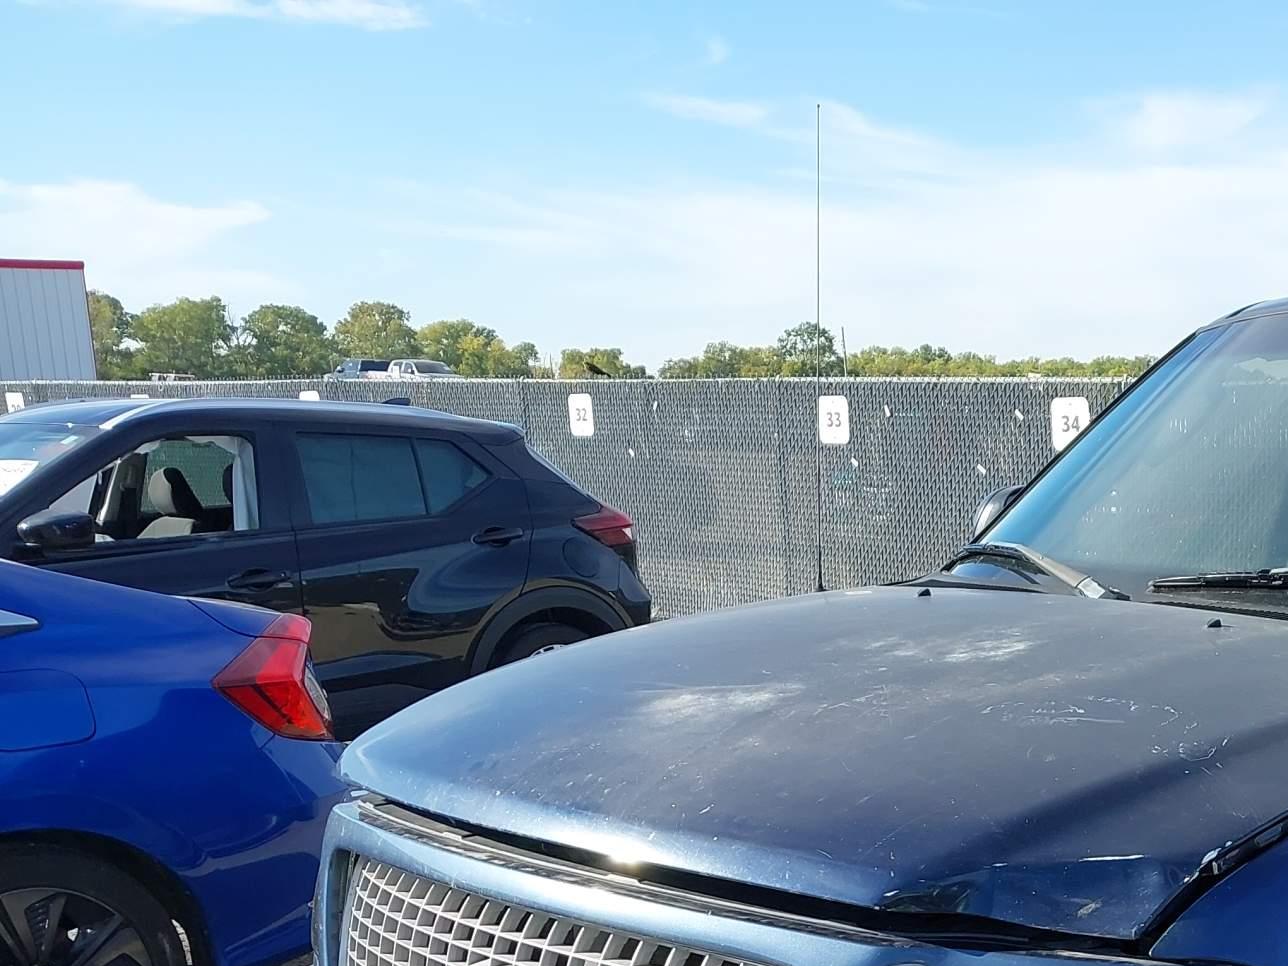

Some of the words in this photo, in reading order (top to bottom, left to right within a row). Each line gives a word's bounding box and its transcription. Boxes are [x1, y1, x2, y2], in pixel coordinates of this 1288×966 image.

[575, 407, 588, 422] 32
[826, 412, 842, 428] 33
[1061, 415, 1080, 433] 34
